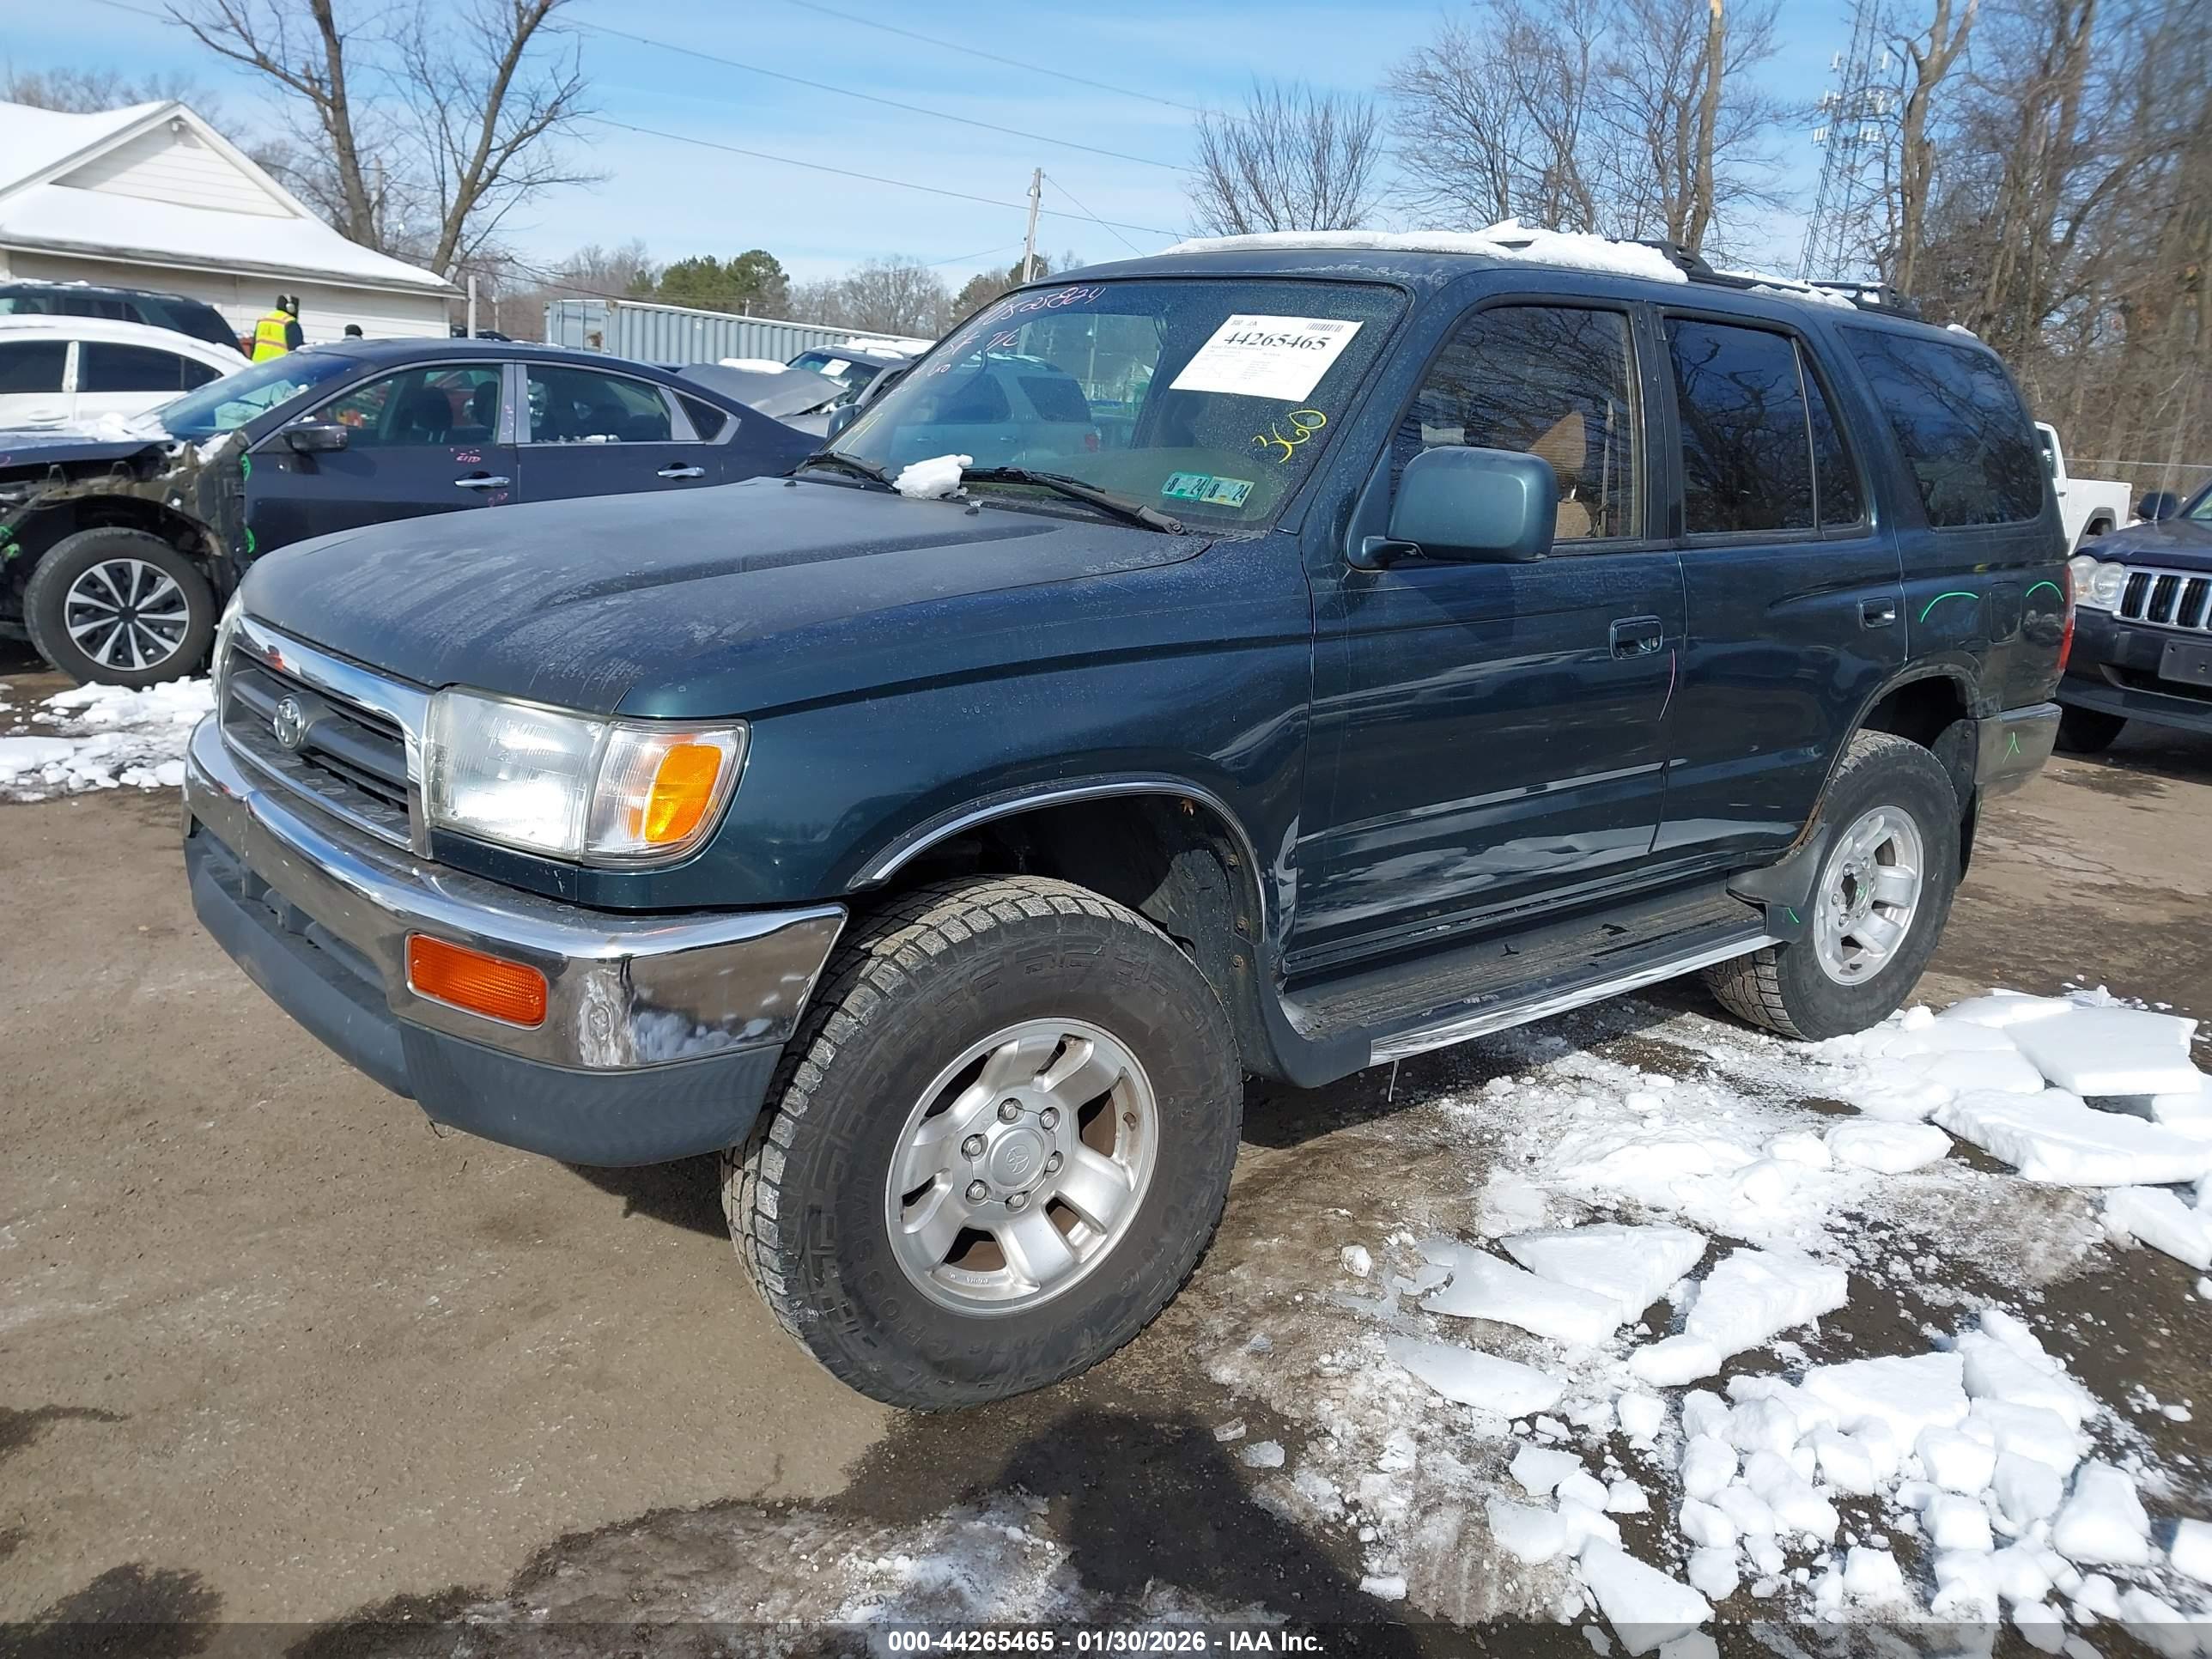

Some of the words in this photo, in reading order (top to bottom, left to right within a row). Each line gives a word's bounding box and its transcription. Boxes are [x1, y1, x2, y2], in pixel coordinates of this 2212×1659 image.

[1224, 331, 1332, 350] 44265465
[1190, 478, 1207, 495] 24
[1232, 484, 1251, 502] 24
